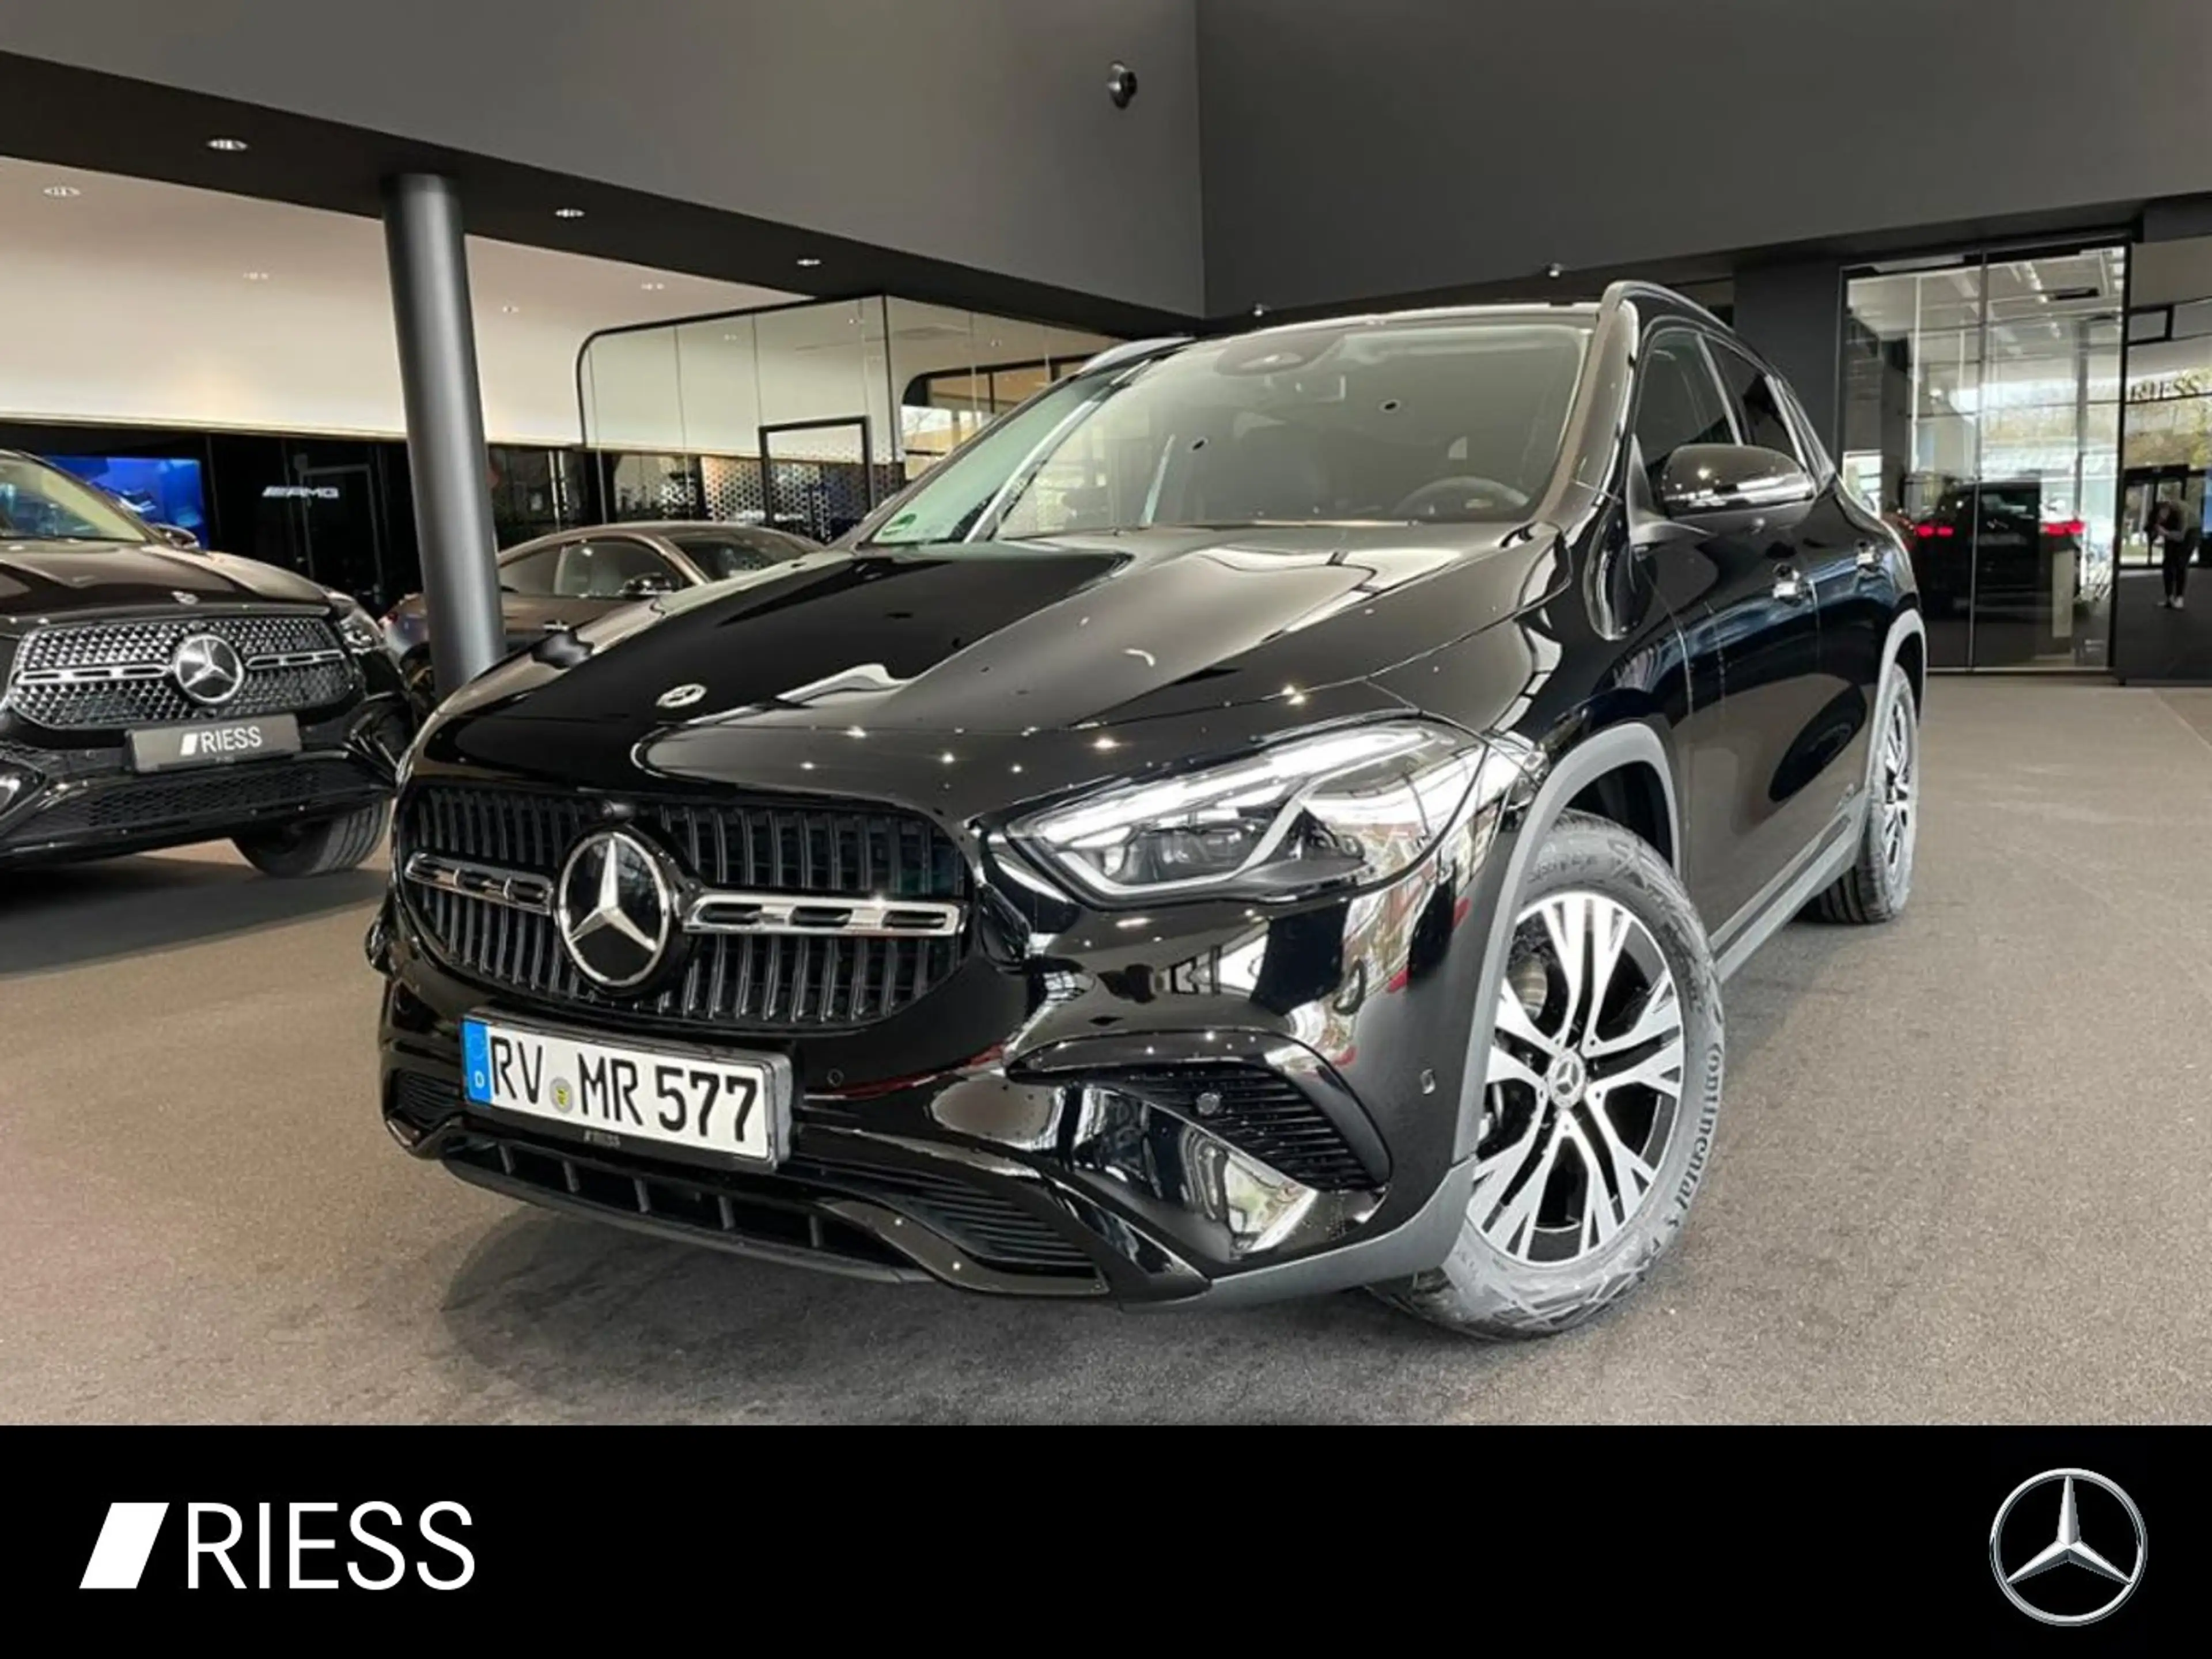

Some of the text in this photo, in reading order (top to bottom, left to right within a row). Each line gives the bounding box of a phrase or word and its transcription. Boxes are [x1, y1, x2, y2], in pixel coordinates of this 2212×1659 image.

[201, 726, 263, 753] RIESS
[490, 1036, 757, 1142] RV MR 577
[1675, 1043, 1723, 1210] Continental
